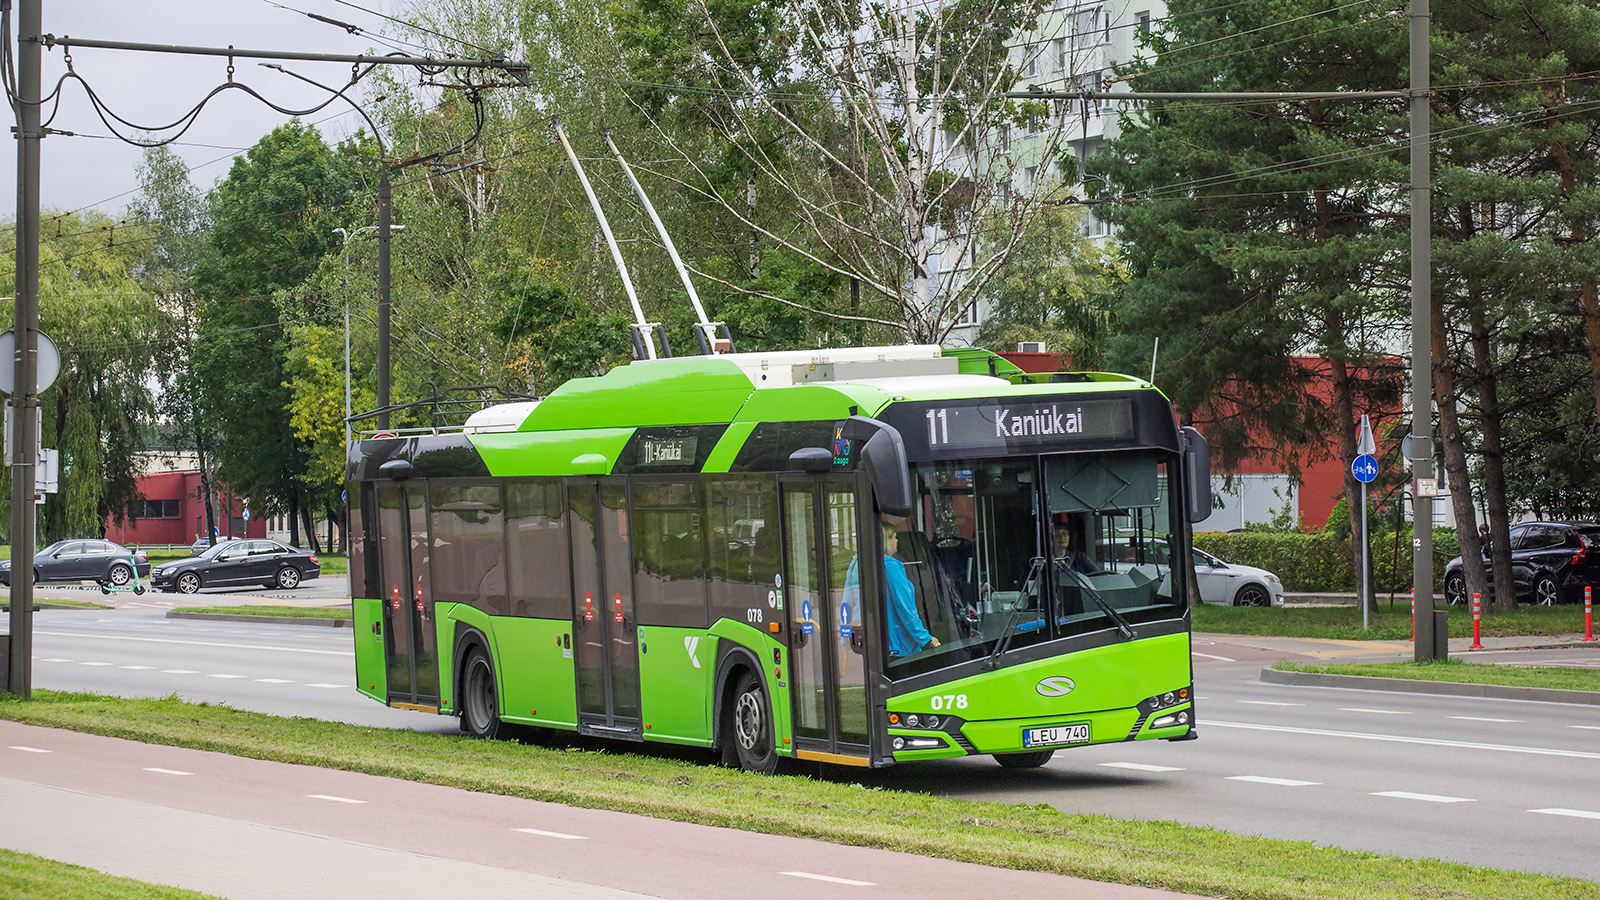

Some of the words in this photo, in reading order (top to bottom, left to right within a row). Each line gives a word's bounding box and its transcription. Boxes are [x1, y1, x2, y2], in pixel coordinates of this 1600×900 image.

[926, 408, 949, 445] 11
[994, 404, 1083, 438] Kaniūkai
[747, 608, 763, 623] 078
[930, 693, 969, 711] 078
[1031, 728, 1058, 743] LEU
[1065, 726, 1087, 740] 740
